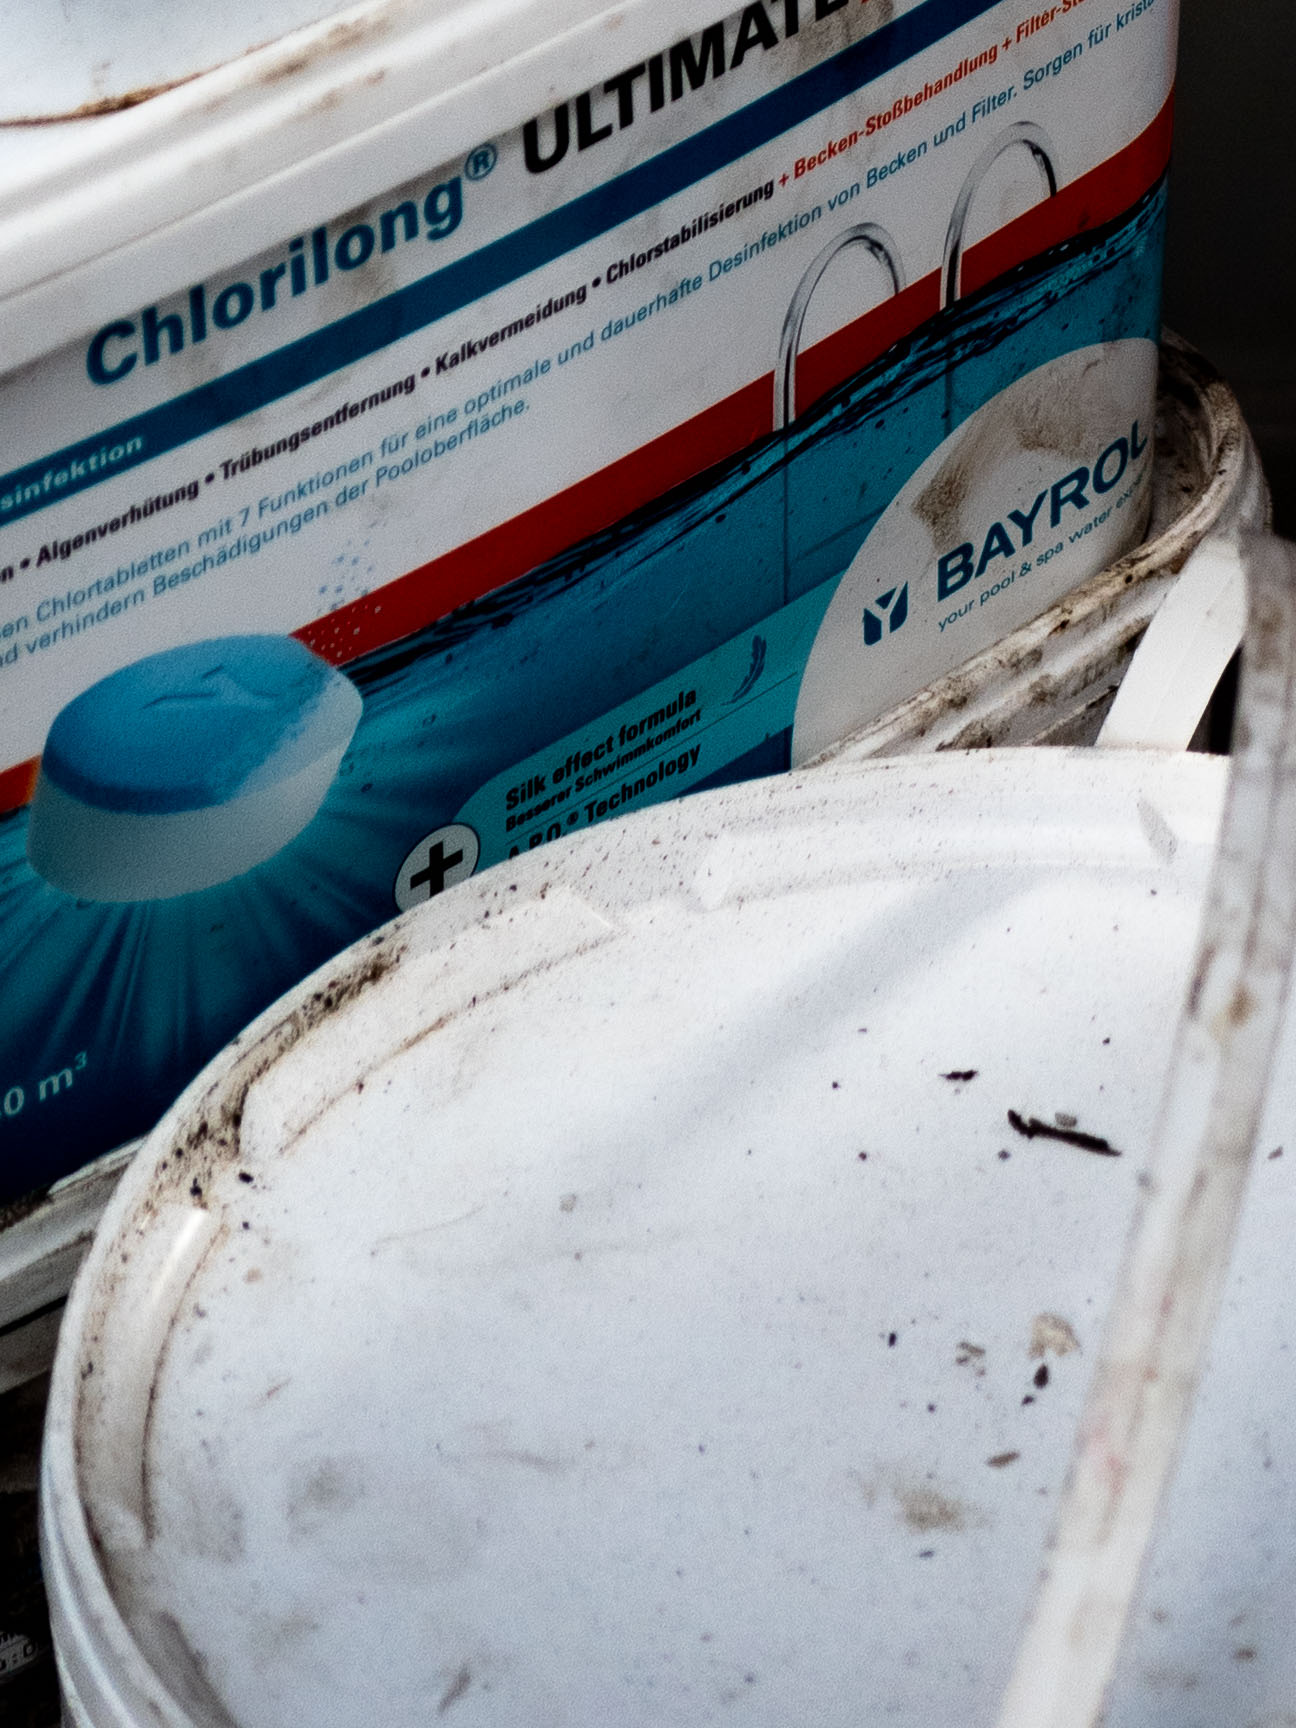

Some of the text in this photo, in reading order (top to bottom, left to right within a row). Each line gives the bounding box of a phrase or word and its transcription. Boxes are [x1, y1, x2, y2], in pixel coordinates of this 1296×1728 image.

[36, 538, 191, 623] Chlortabletten
[258, 452, 375, 518] Funktionen
[600, 274, 703, 342] dauerhafte
[709, 205, 822, 282] Desinfektion
[933, 115, 967, 148] und
[1023, 42, 1083, 91] Sorgen
[1088, 23, 1113, 50] für
[36, 480, 200, 568] Algenverhütung
[220, 374, 416, 480] Trübungsentfernung
[435, 284, 587, 376] Kalkvermeidung
[606, 178, 774, 285] Chlorstabilisierung
[938, 419, 1148, 602] BAYROL
[938, 508, 1112, 632] your pool water
[506, 690, 697, 811] Silk effect formula
[506, 709, 701, 832] Besserer Schwimmkomfort
[584, 744, 700, 823] Technology
